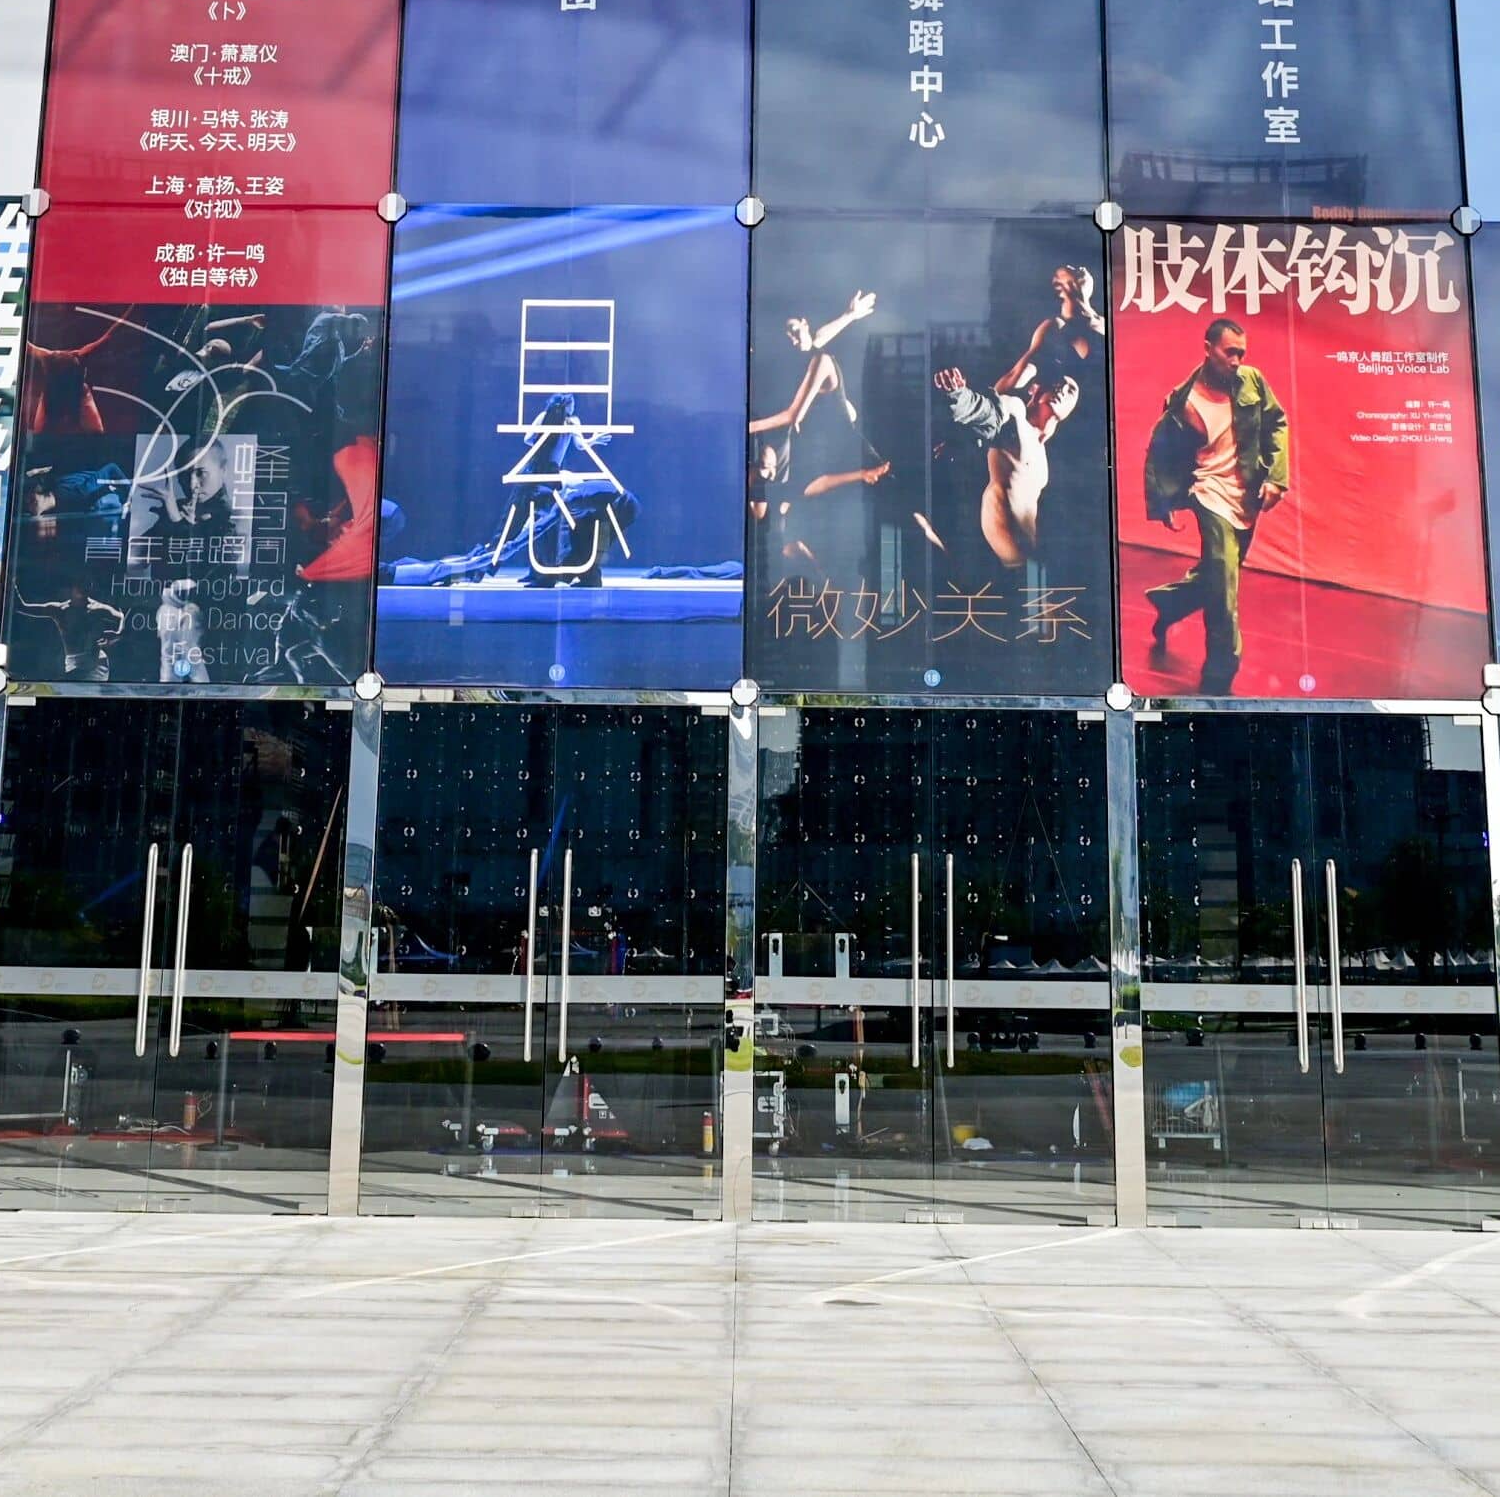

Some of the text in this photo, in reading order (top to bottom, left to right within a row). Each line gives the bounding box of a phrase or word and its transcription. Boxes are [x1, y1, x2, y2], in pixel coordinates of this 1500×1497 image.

[206, 2, 246, 21] 《卜》
[192, 67, 252, 85] 《十戒》
[139, 133, 297, 152] 《昨天、今天、明天》
[182, 199, 243, 219] 《对视》
[157, 267, 260, 287] 《独自等待》
[1119, 223, 1460, 315] 肢体钩沉
[1358, 363, 1449, 375] Beijing Voice Lab
[111, 574, 285, 601] Hummingbird
[122, 608, 281, 631] Youth Dance
[768, 578, 1092, 643] 微妙关系
[172, 642, 279, 664] Festival
